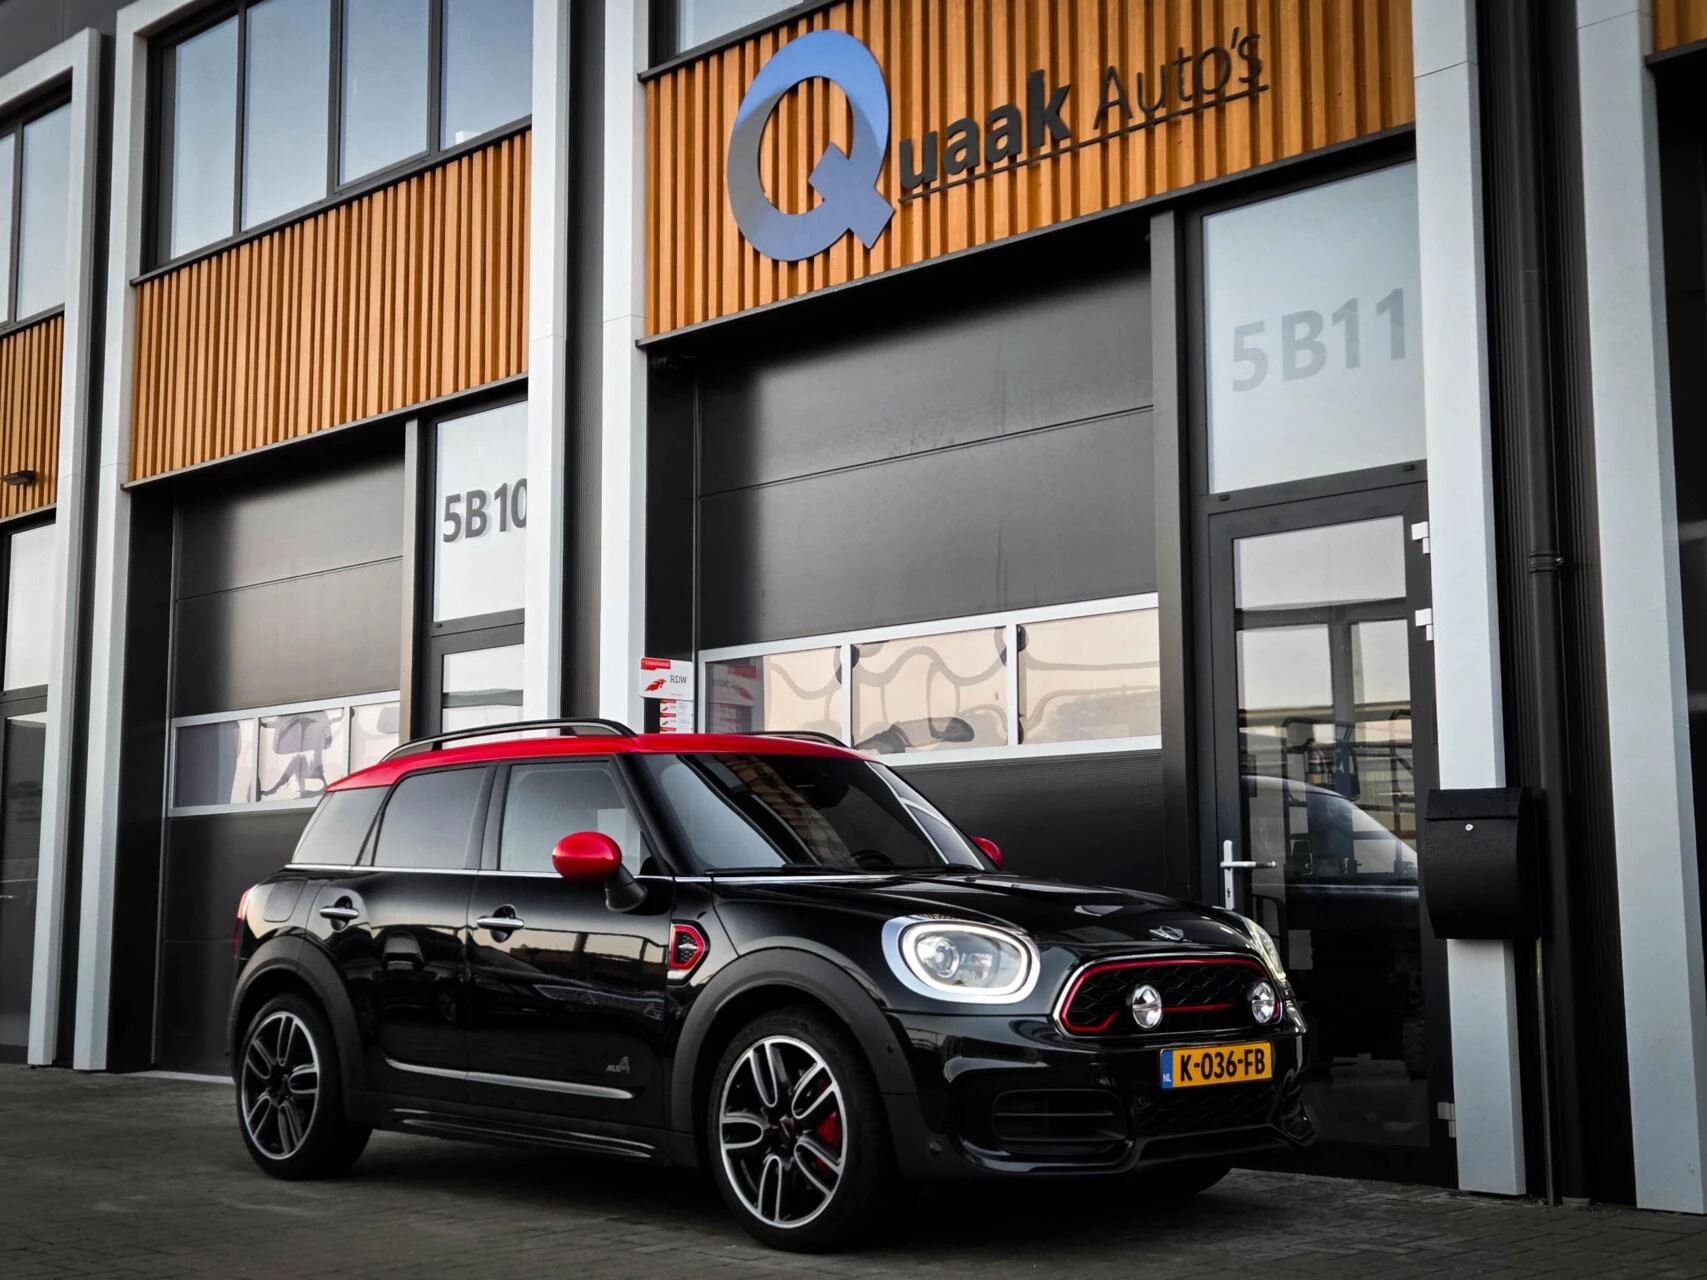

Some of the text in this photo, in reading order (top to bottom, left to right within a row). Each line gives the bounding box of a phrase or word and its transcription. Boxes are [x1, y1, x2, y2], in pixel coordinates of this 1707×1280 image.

[727, 27, 1262, 262] Quaak Auto's
[1232, 287, 1406, 392] 5B11
[443, 478, 528, 543] 5B10
[669, 674, 688, 684] RDW
[1162, 1073, 1172, 1083] NL
[1179, 1048, 1266, 1082] K-036-FB
